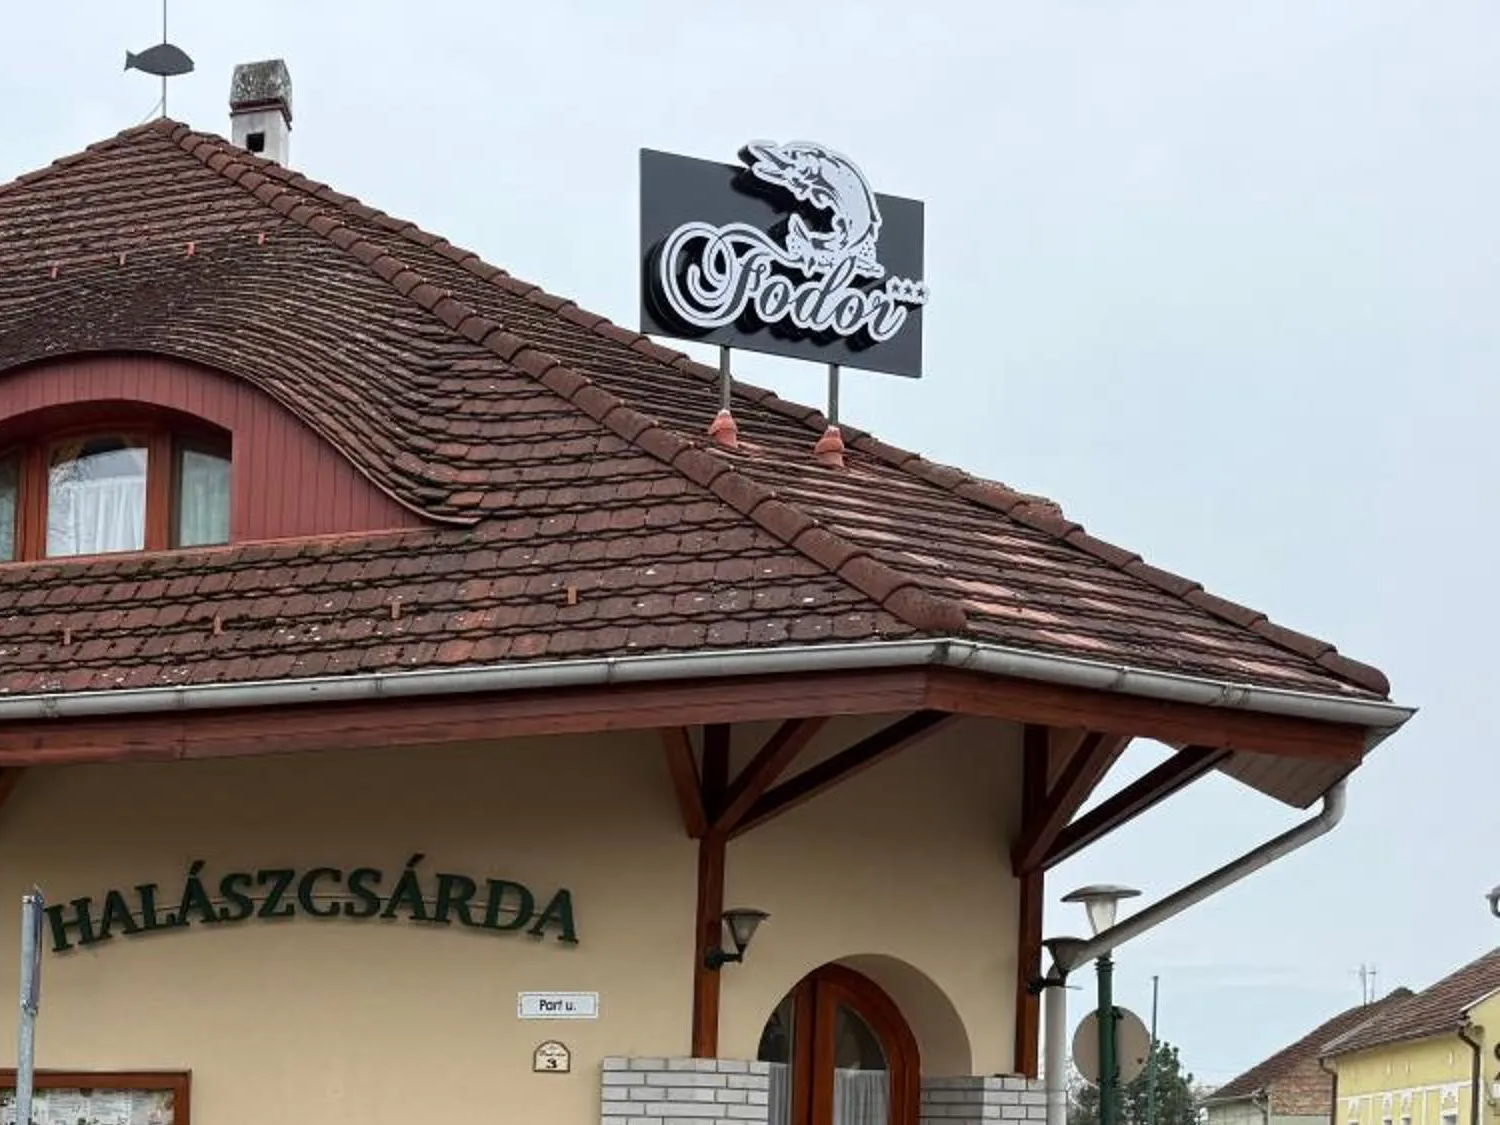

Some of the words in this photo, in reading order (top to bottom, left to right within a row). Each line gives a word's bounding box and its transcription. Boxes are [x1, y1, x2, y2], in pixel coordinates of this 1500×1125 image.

[660, 221, 908, 342] Fodor
[43, 853, 580, 952] HALÁSZCSÁRDA
[539, 999, 563, 1011] Part
[565, 1001, 577, 1011] u.
[546, 1058, 557, 1069] 3
